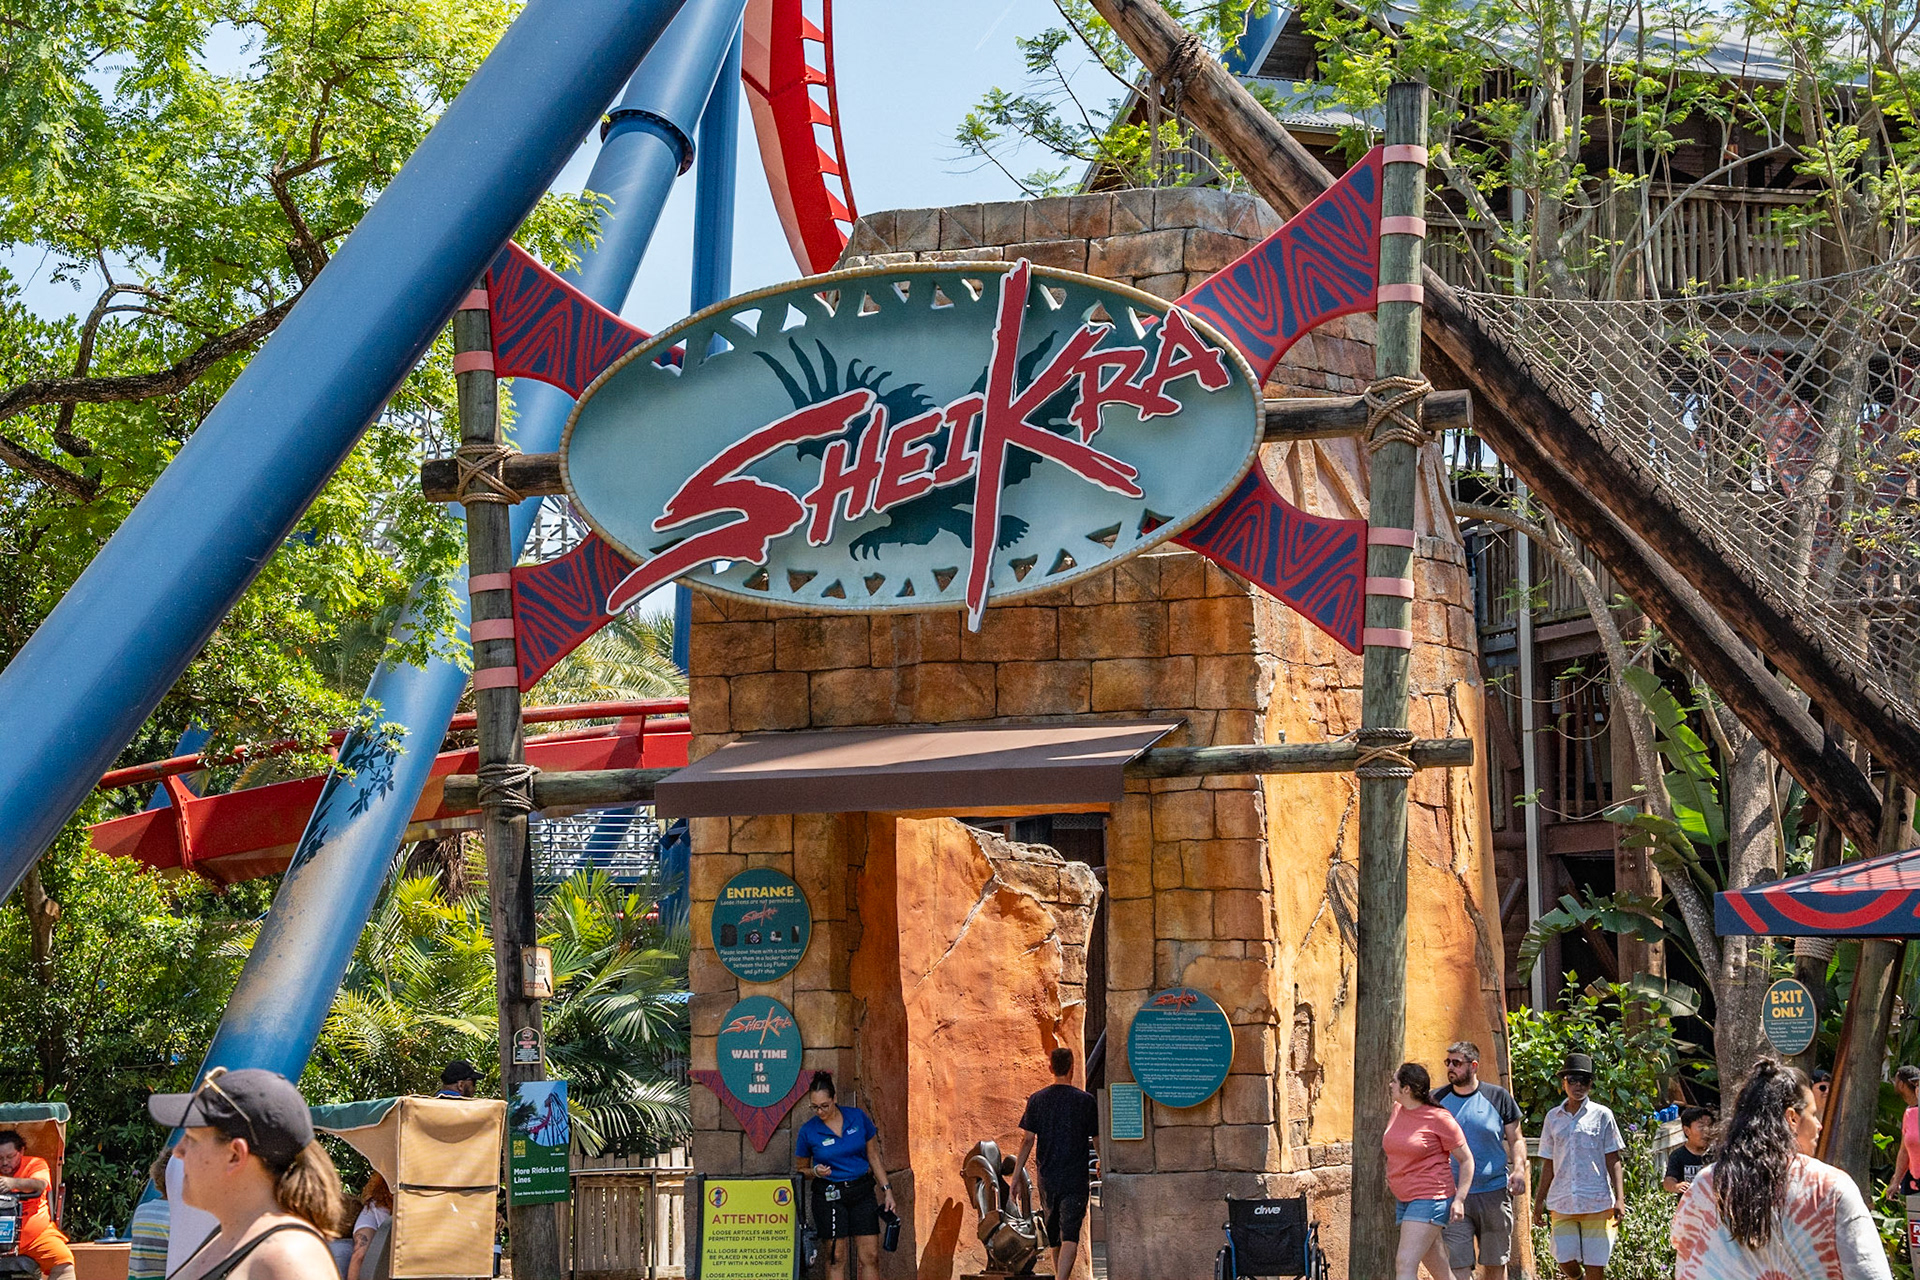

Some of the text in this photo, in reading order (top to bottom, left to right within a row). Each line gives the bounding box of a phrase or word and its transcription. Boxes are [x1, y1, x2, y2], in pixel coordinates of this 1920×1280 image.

[727, 886, 794, 898] ENTRANCE
[1770, 990, 1803, 1004] EXIT
[1772, 1006, 1804, 1018] ONLY
[731, 1049, 787, 1059] WAIT TIME
[754, 1062, 764, 1072] IS
[748, 1084, 770, 1093] MIN
[1254, 1205, 1281, 1215] drive
[712, 1214, 788, 1224] ATTENTION
